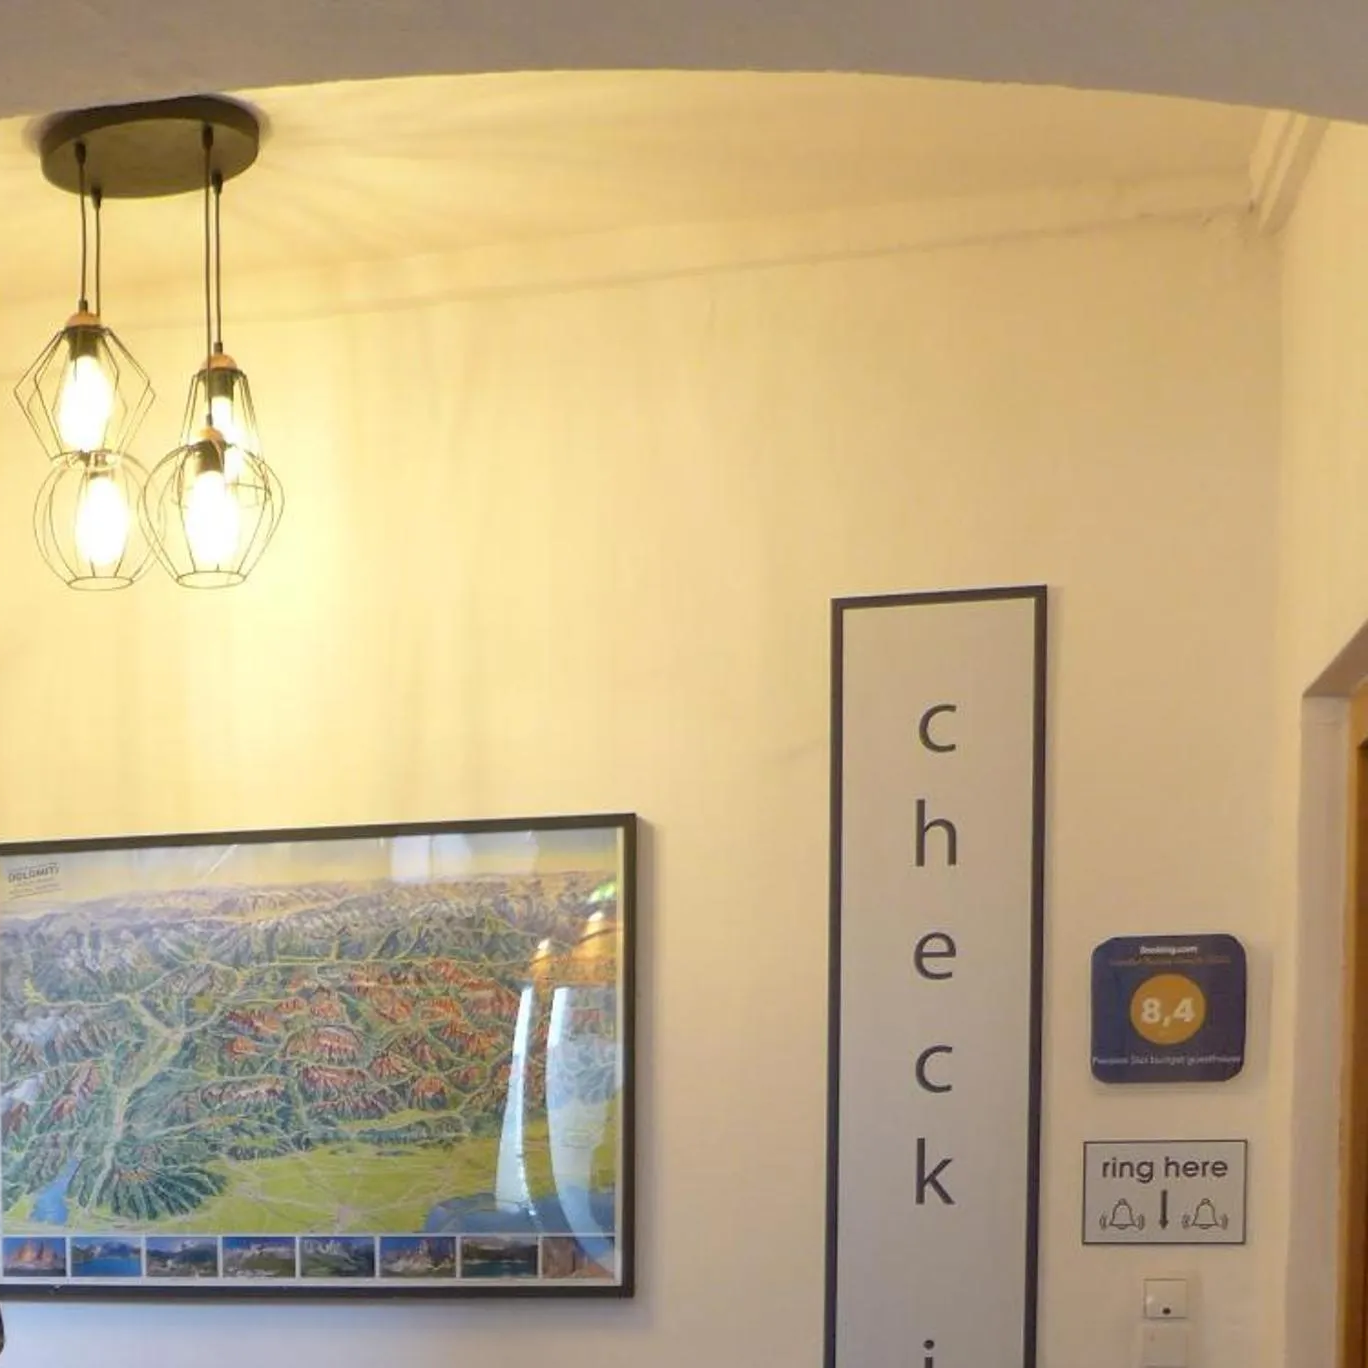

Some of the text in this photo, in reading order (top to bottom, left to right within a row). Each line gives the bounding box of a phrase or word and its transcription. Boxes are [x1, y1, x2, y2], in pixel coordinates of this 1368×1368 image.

[913, 701, 958, 1206] check
[1141, 998, 1196, 1028] 8,4
[1102, 1156, 1229, 1184] ring here
